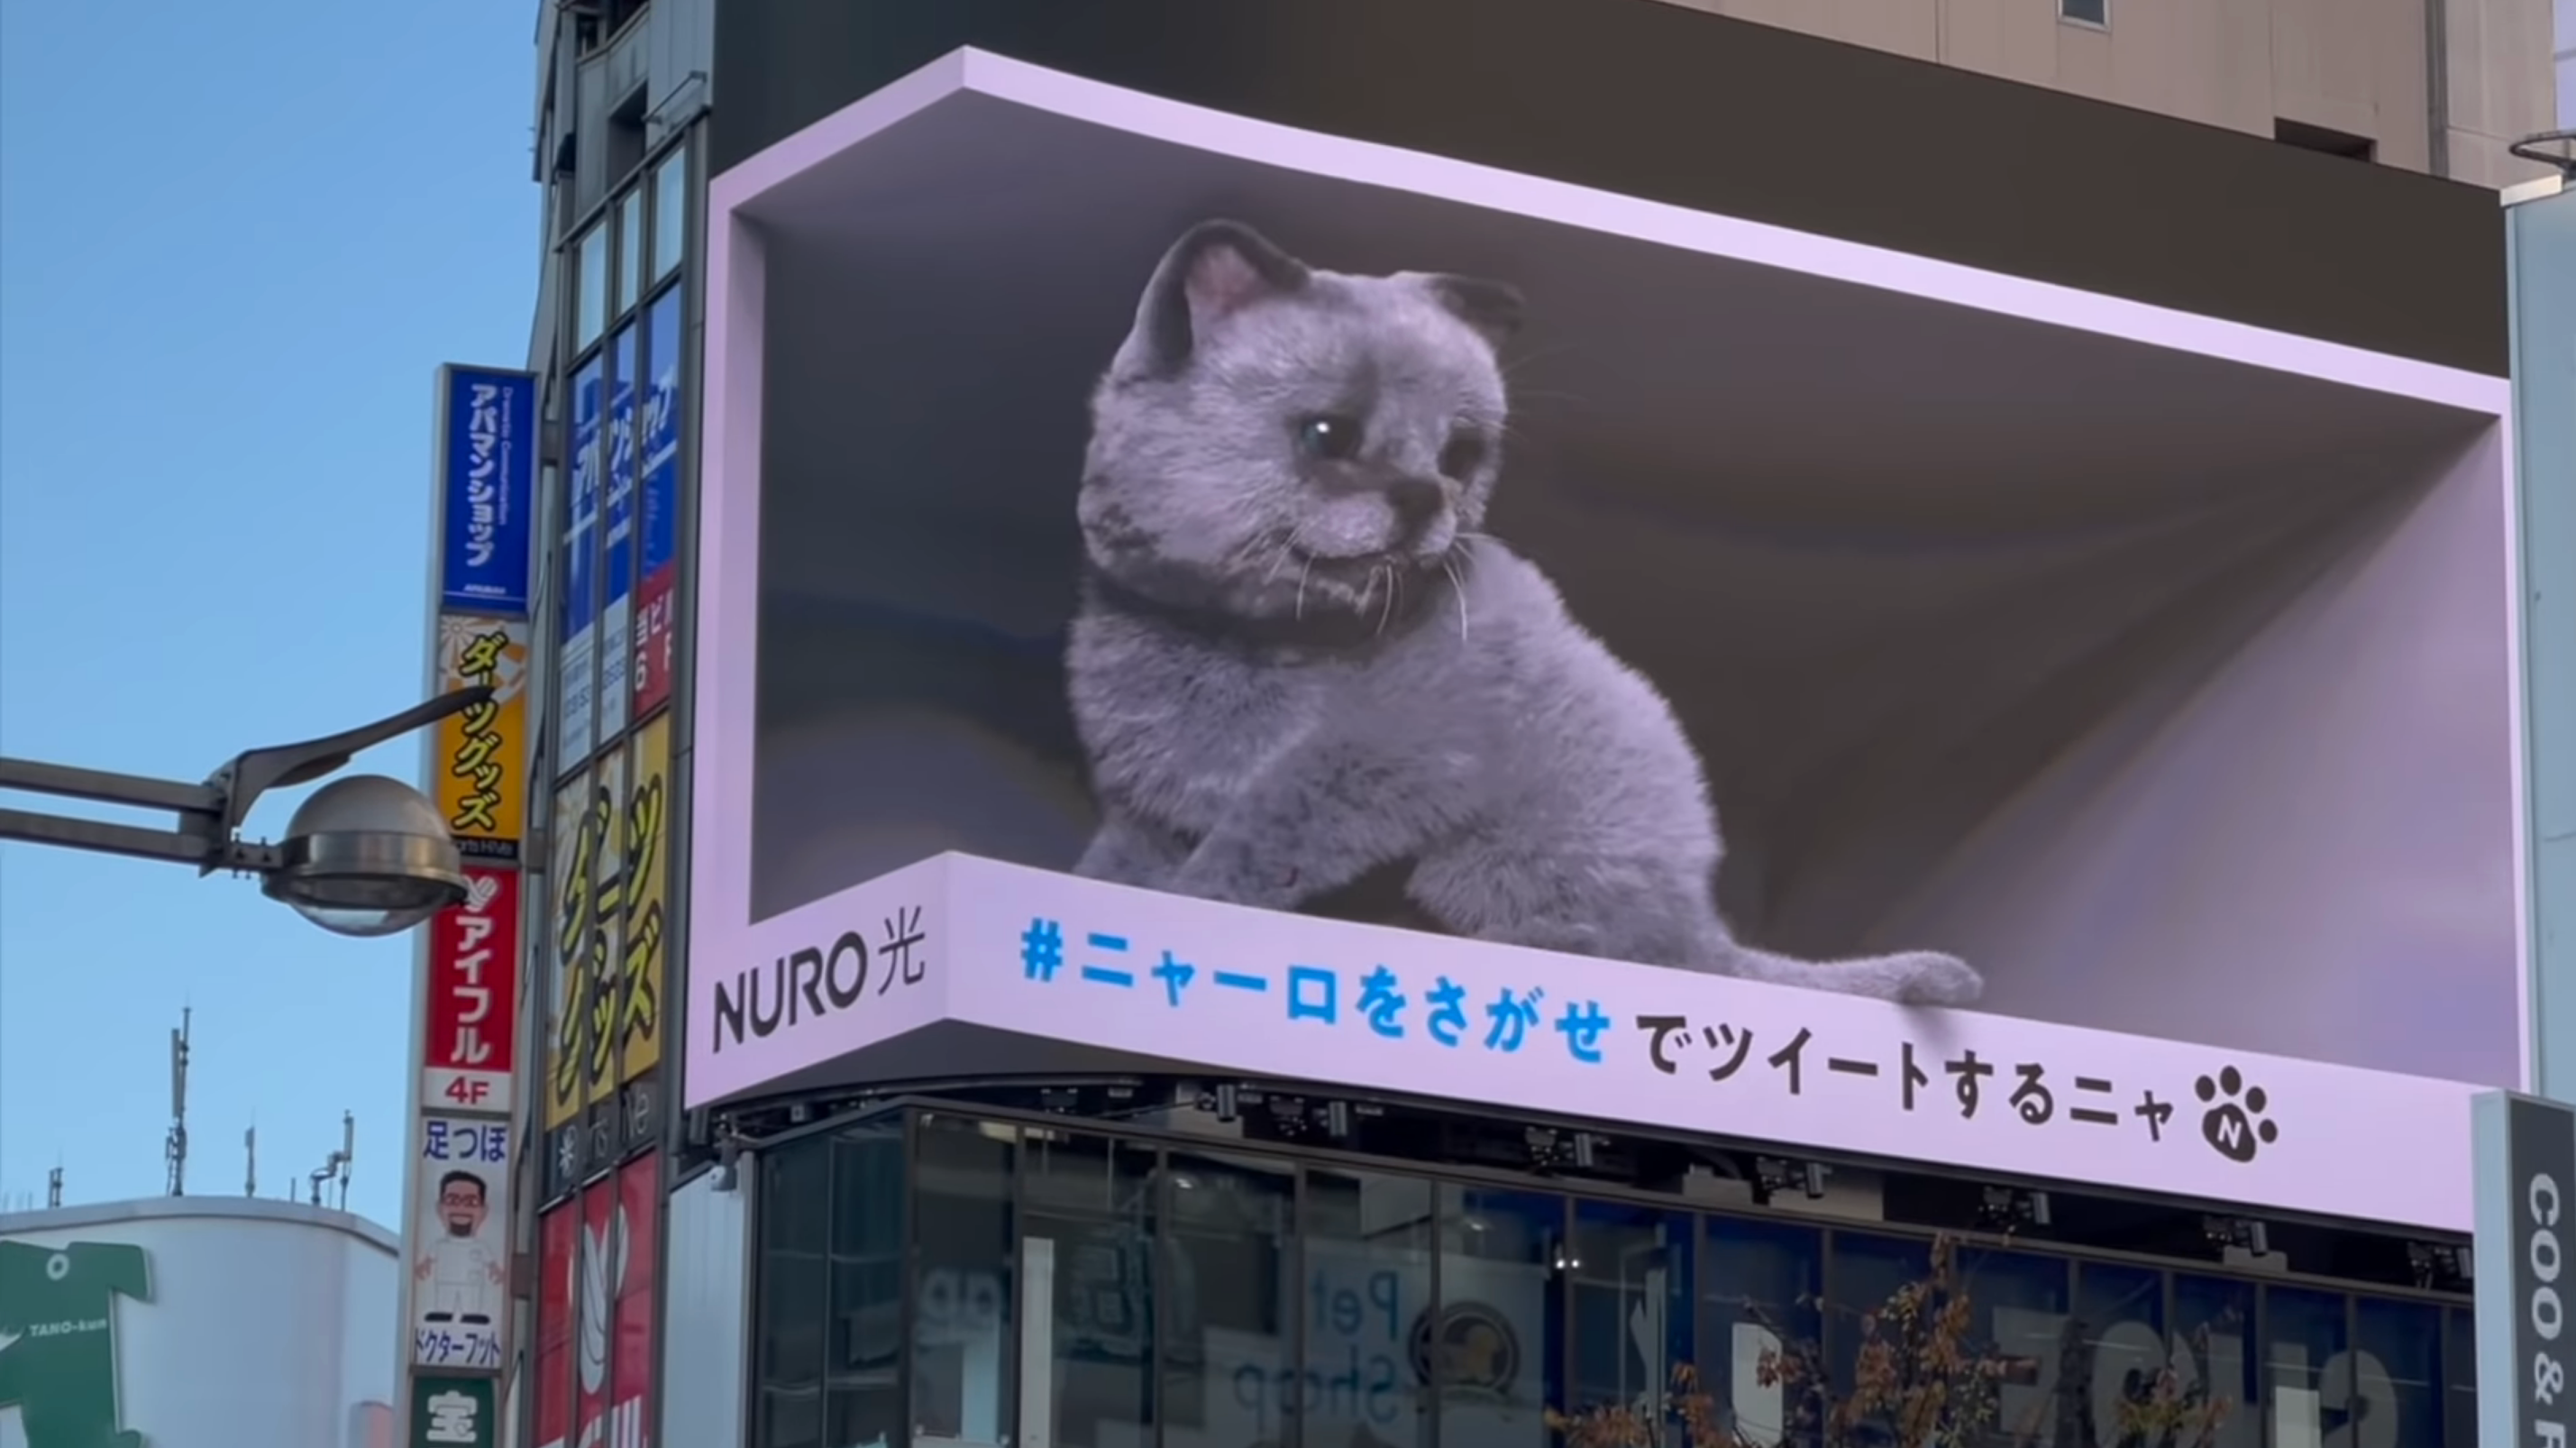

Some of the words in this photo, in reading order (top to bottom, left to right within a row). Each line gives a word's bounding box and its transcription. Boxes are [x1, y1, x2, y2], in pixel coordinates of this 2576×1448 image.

[464, 383, 498, 567] アパマンショップ
[452, 632, 507, 830] ダーツグッズ
[450, 915, 492, 1065] アイフル
[713, 931, 868, 1054] NURO
[878, 905, 926, 996] 光
[444, 1076, 490, 1104] 4F
[2218, 1113, 2243, 1150] N
[2529, 1173, 2563, 1341] COO
[29, 1317, 107, 1337] TANO-kun
[415, 1327, 501, 1366] ドクターフット
[2534, 1352, 2564, 1407] &
[426, 1390, 478, 1443] 宝
